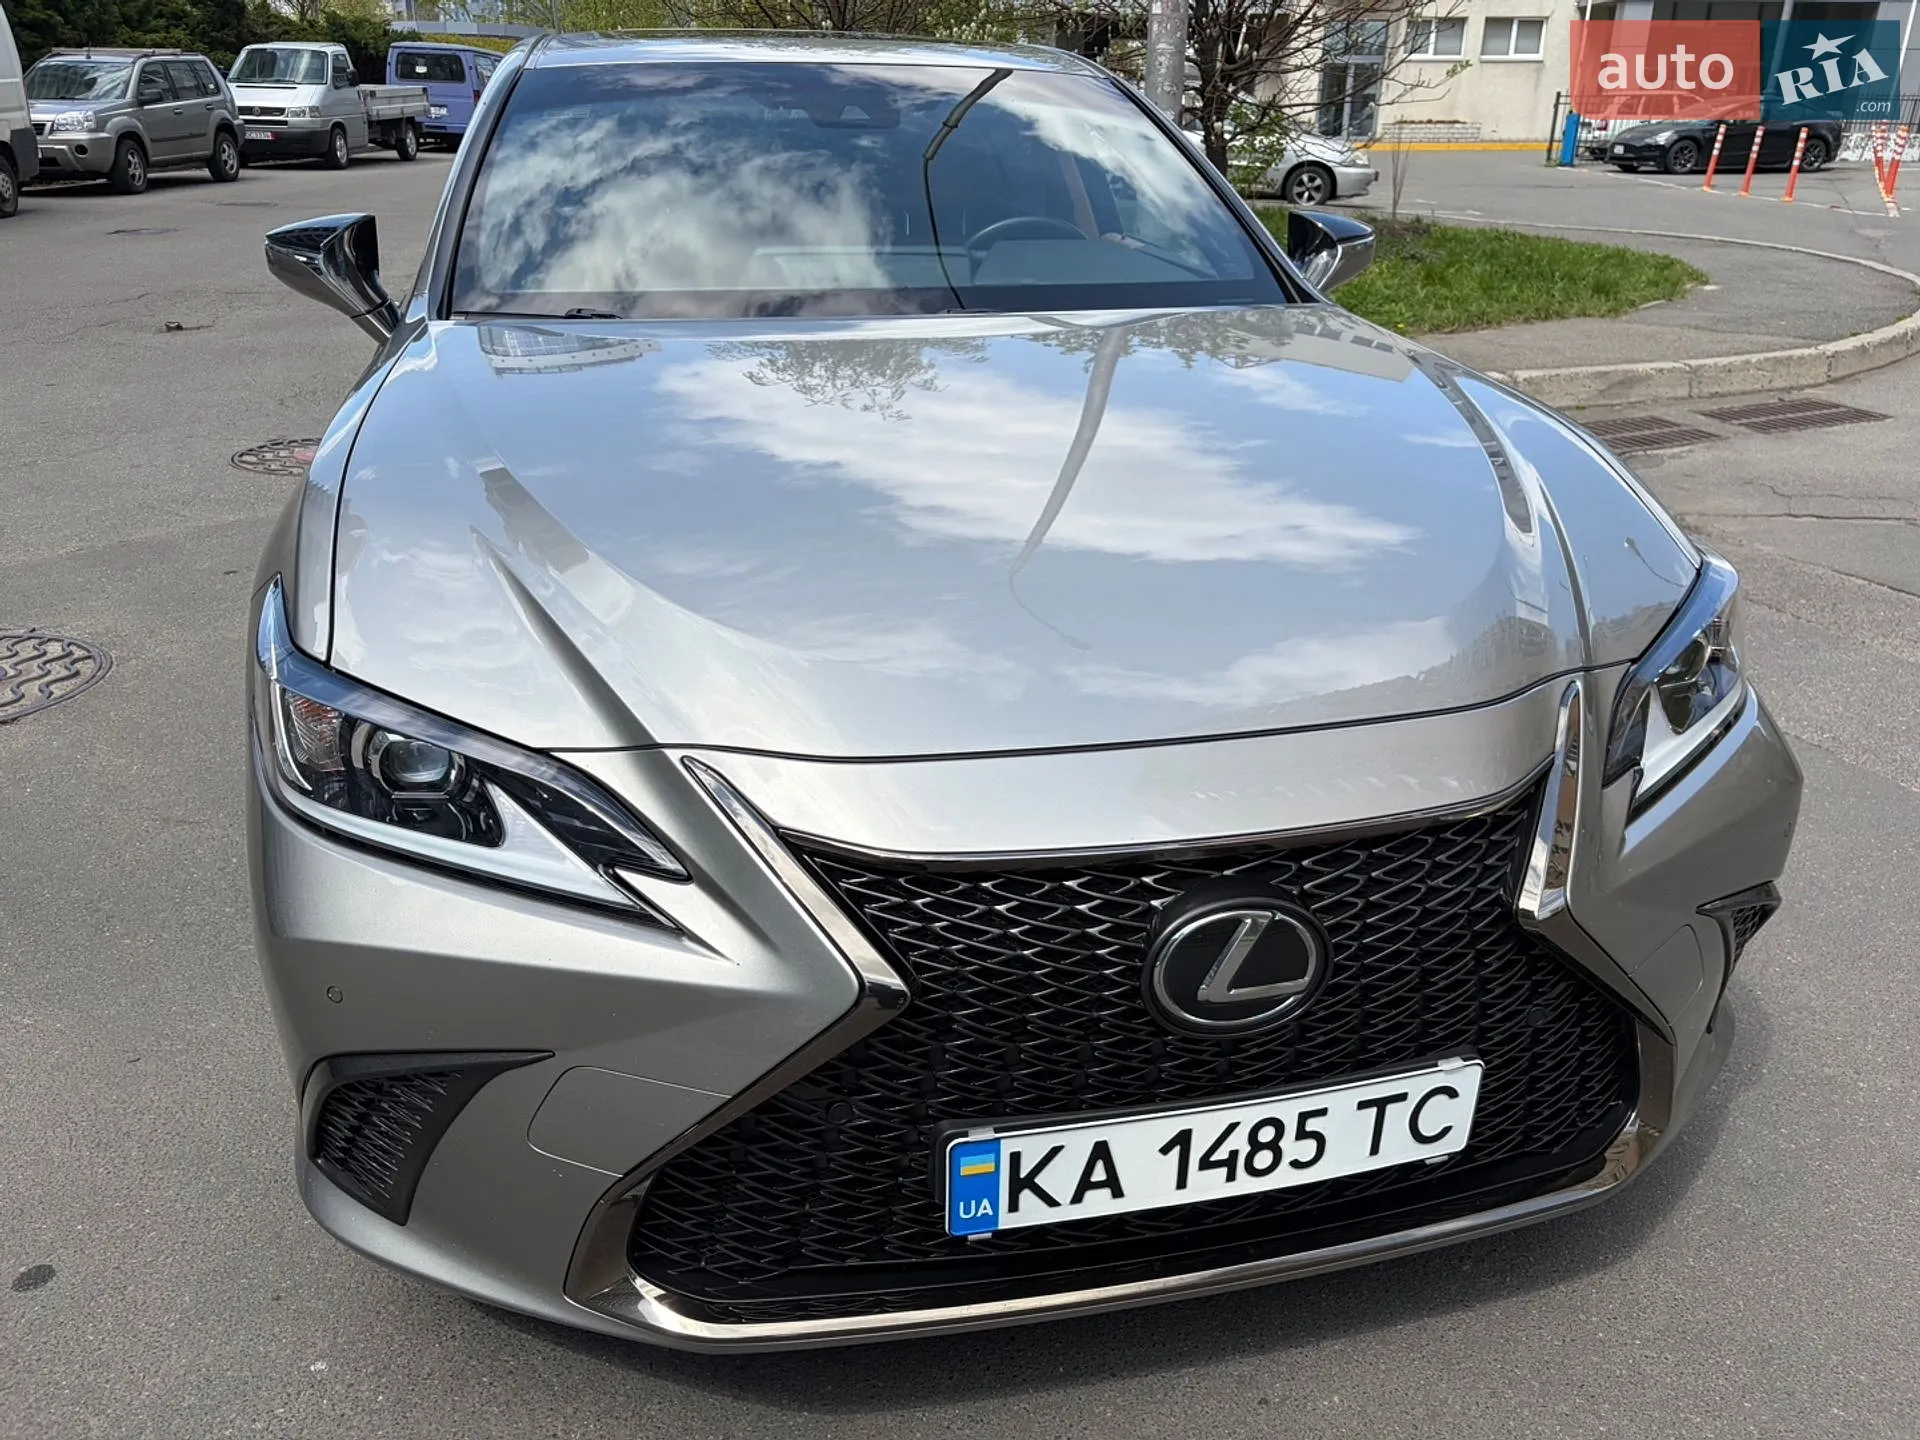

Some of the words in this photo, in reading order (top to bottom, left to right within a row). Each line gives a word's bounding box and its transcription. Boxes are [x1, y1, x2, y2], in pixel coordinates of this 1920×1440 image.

[1007, 1139, 1126, 1214] KA
[1157, 1106, 1329, 1190] 1485
[1355, 1085, 1460, 1157] TC
[958, 1198, 994, 1220] UA
